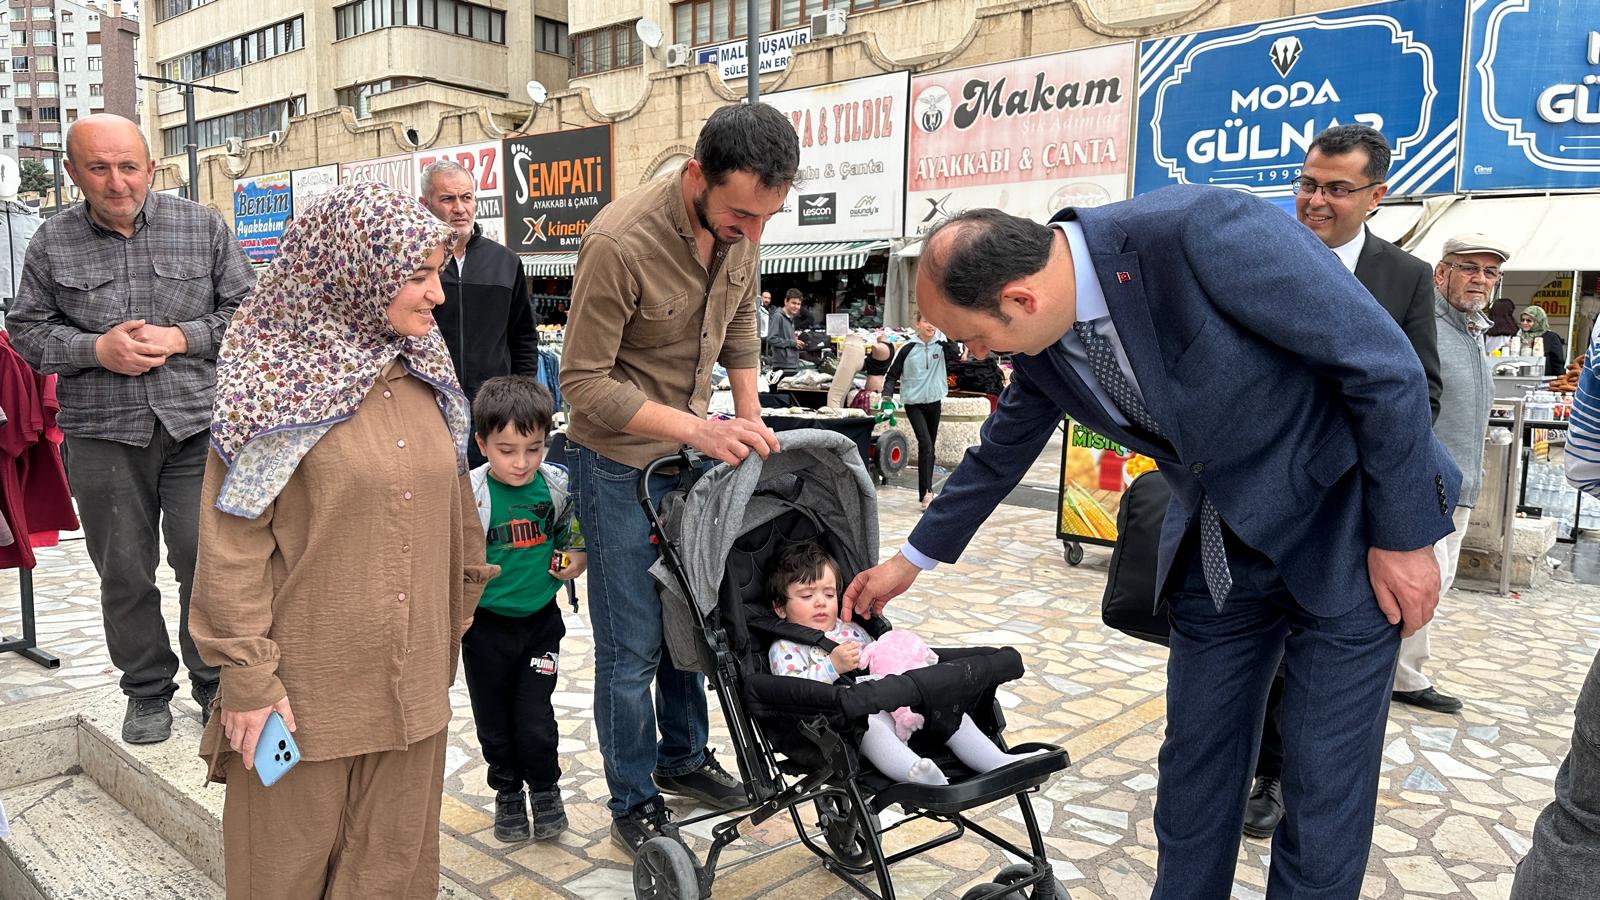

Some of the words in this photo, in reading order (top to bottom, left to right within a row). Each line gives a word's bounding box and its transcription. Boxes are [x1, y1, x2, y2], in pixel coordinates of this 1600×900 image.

[954, 71, 1122, 129] Makam
[1231, 78, 1341, 114] MODA
[833, 96, 893, 144] YILDIZ
[1186, 112, 1384, 164] GÜLN
[824, 163, 835, 179] &
[839, 158, 884, 180] Çanta
[915, 148, 1010, 180] AYAKKABI
[1019, 147, 1033, 170] &
[1042, 137, 1117, 174] ÇANTA
[1257, 168, 1302, 182] 1999
[236, 190, 290, 217] Benim
[475, 199, 500, 217] ANTA
[533, 199, 567, 210] AYAKKABI
[574, 196, 599, 209] ÇANTA
[237, 217, 285, 237] Ayakkabım
[487, 521, 542, 546] PUMA
[530, 656, 555, 669] PUMA
